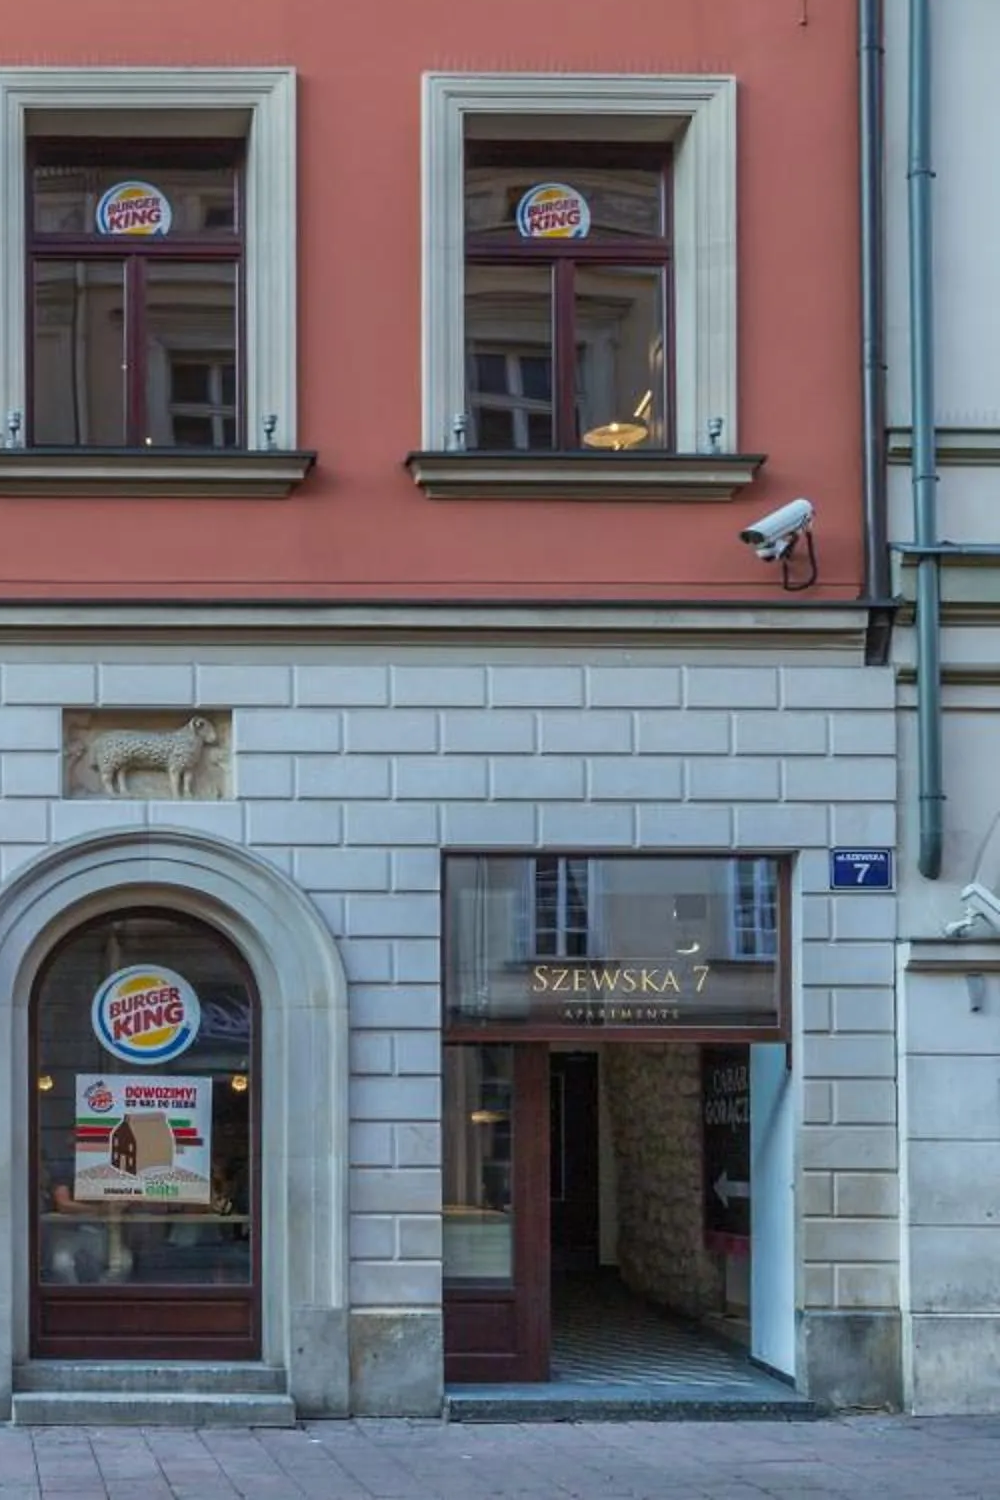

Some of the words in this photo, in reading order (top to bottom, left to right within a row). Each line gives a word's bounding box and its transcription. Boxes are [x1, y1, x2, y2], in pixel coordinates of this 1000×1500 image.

[109, 209, 162, 230] KING
[530, 209, 581, 231] KING
[853, 863, 870, 884] 7
[693, 965, 710, 993] 7
[109, 987, 181, 1020] BURGER
[113, 1002, 184, 1040] KING
